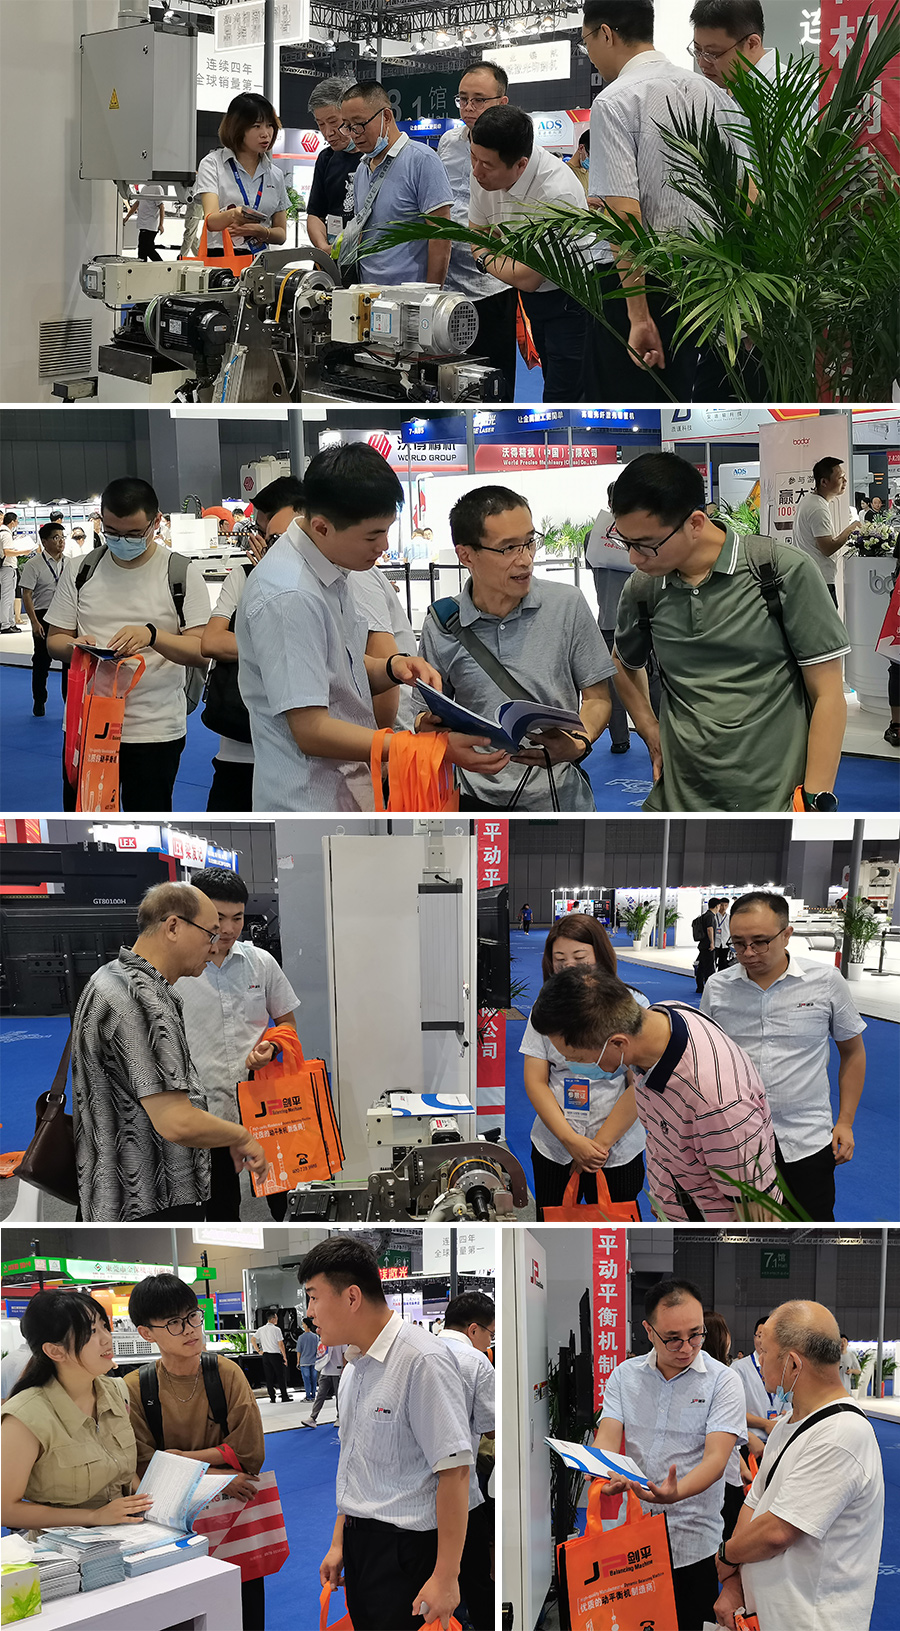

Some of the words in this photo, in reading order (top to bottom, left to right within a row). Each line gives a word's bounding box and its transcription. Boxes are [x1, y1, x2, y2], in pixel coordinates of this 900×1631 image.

[206, 58, 252, 75] 连续四年
[197, 73, 263, 91] 全球销量第一
[429, 86, 447, 110] 馆
[538, 120, 562, 130] ADS
[255, 1099, 283, 1118] JP
[442, 1235, 475, 1246] 连四年
[434, 1246, 484, 1258] 全球量第一
[584, 1553, 627, 1586] JP
[627, 1545, 652, 1565] 剑平
[609, 1566, 634, 1577] Balancing
[634, 1560, 653, 1570] Machine
